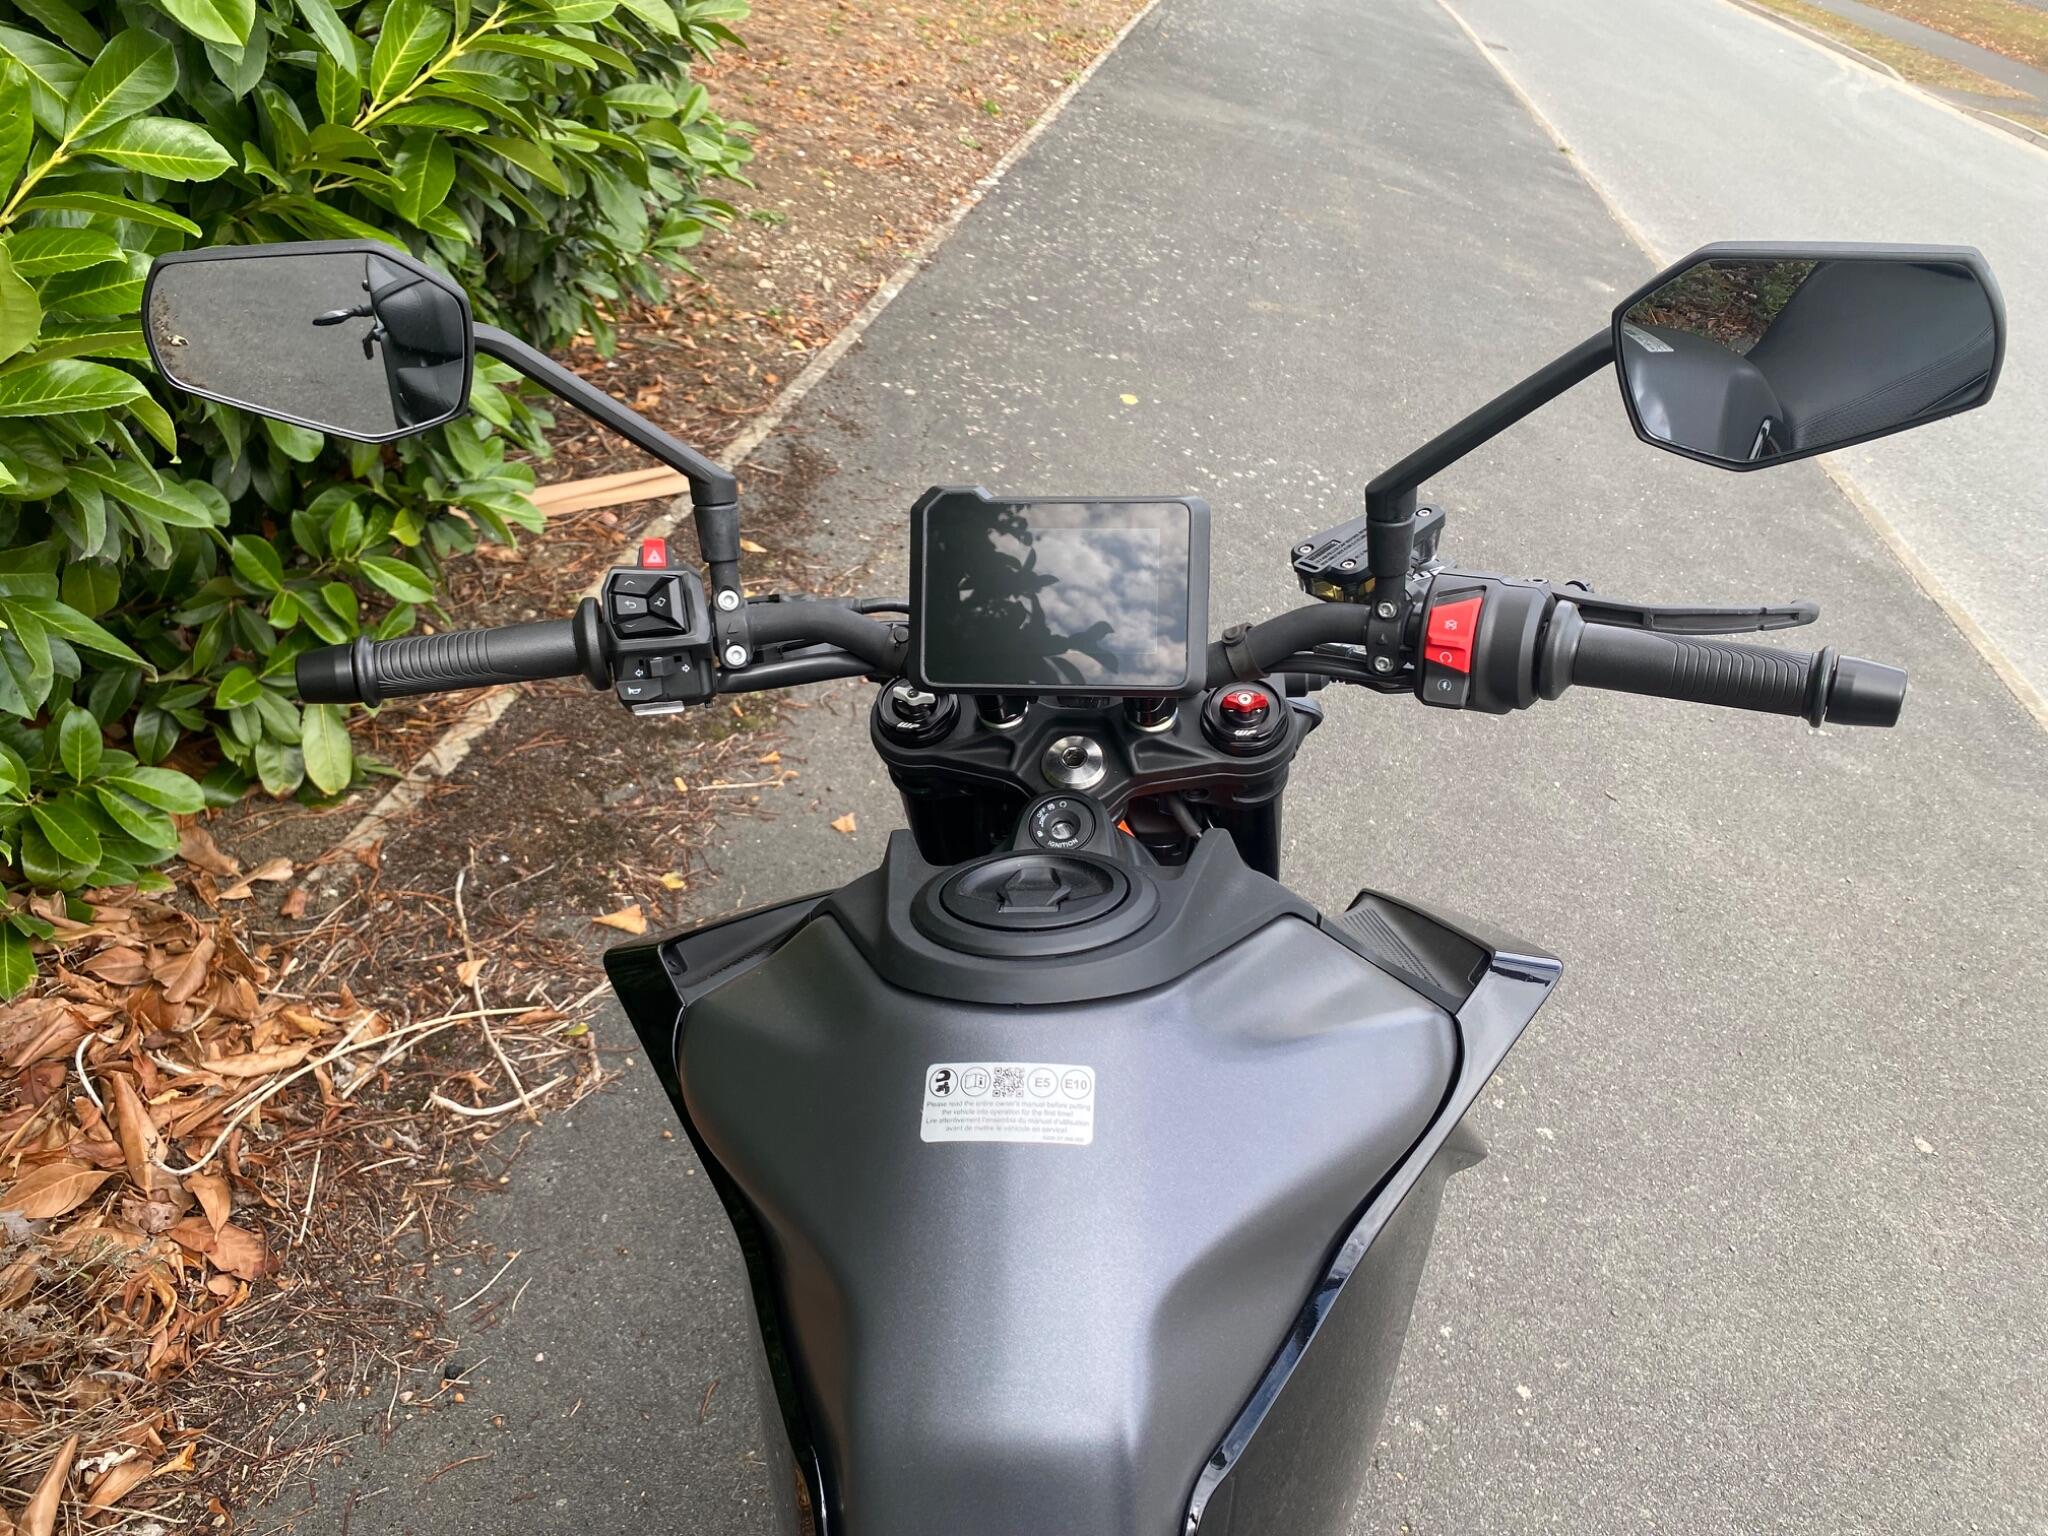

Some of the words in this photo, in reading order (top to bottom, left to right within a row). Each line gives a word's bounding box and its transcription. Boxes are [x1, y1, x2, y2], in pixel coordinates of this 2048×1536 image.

[1047, 837, 1079, 848] IGNITION
[1034, 1077, 1051, 1088] E5
[1064, 1078, 1088, 1090] E10
